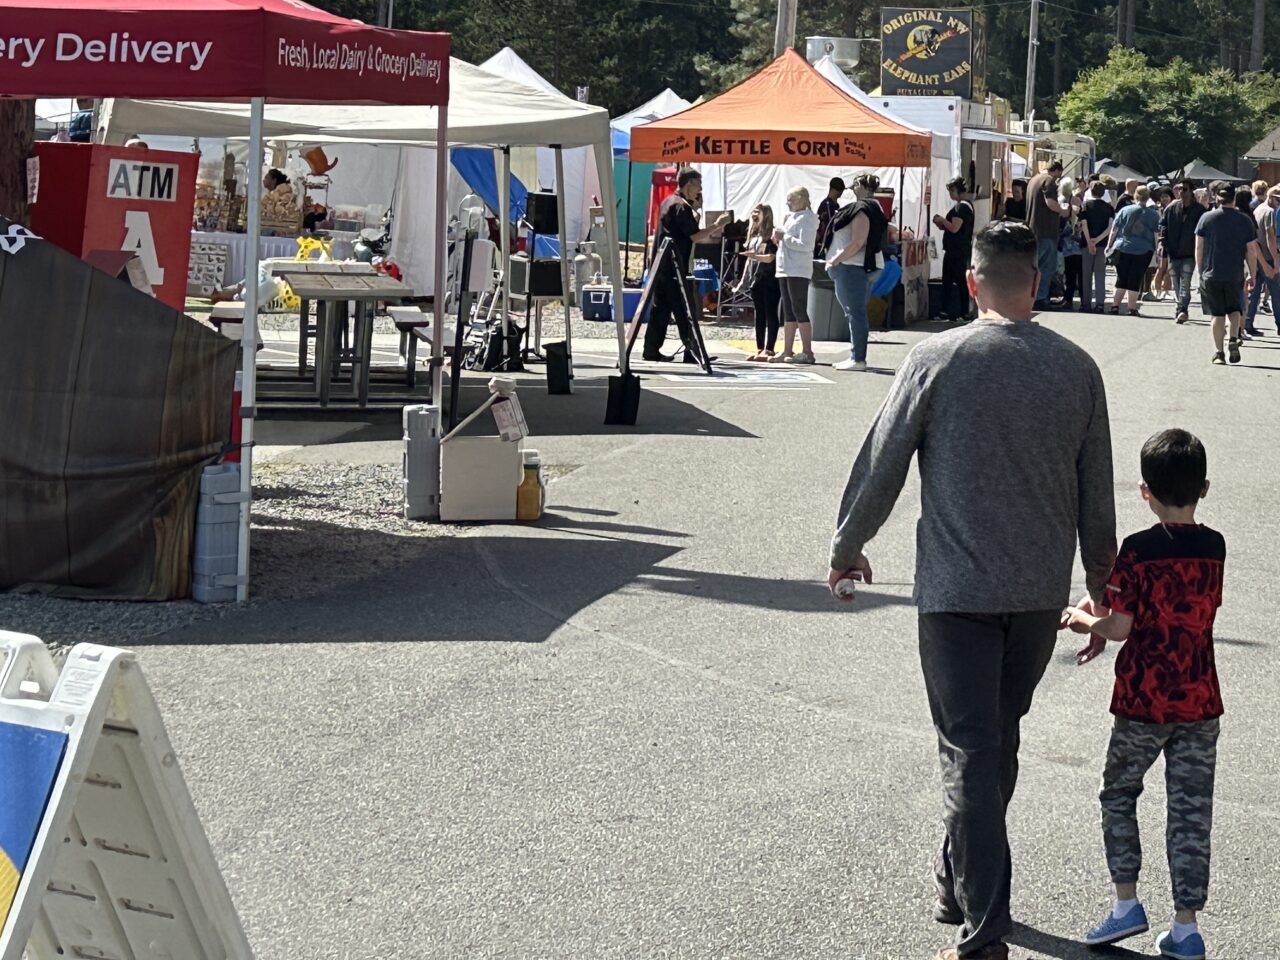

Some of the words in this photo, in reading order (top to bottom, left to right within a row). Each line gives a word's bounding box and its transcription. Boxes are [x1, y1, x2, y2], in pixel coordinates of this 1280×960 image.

[883, 10, 943, 34] ORIGINAL
[945, 15, 970, 35] NW
[56, 32, 213, 71] Delivery
[278, 37, 311, 72] Fresh,
[312, 41, 339, 70] Local
[340, 42, 366, 77] Dairy
[367, 44, 374, 70] &
[375, 46, 408, 81] Grocery
[409, 51, 442, 84] Delivery
[882, 58, 940, 85] ELEPHANT
[943, 61, 972, 83] EARS
[694, 136, 771, 155] KETTLE
[783, 137, 840, 157] CORN
[109, 163, 173, 199] ATM
